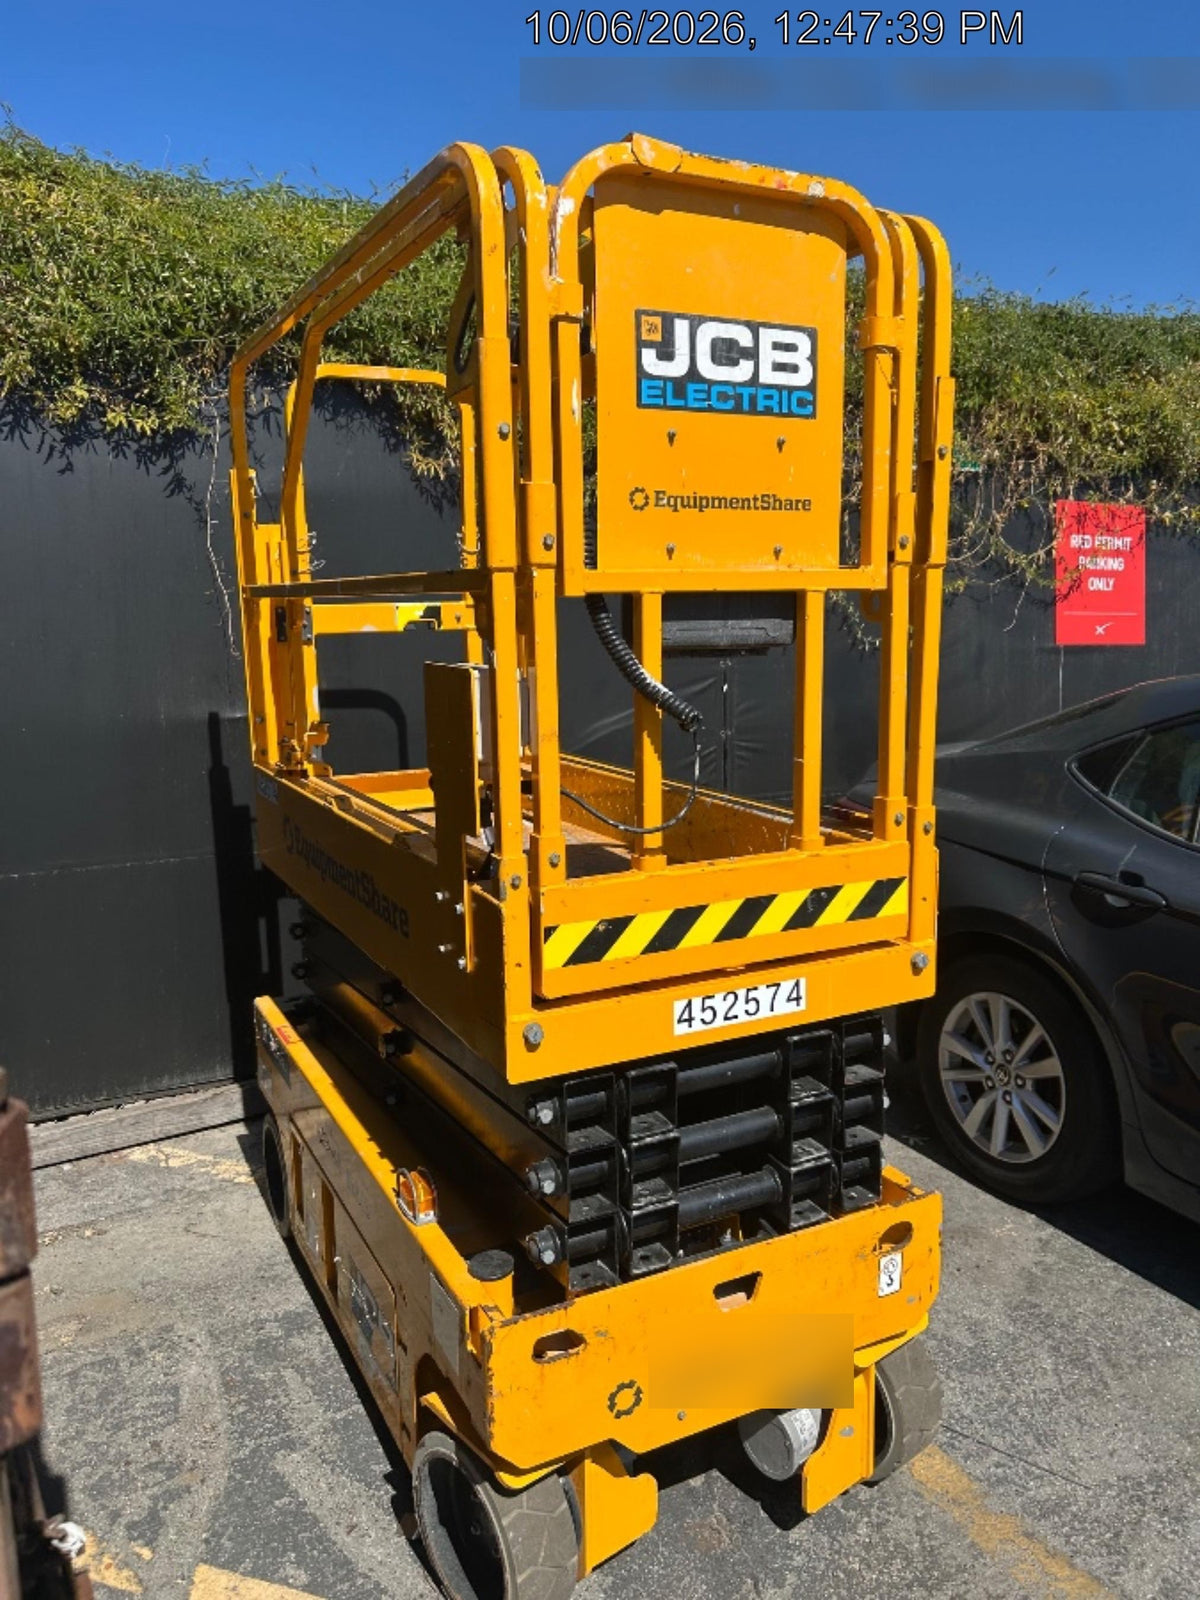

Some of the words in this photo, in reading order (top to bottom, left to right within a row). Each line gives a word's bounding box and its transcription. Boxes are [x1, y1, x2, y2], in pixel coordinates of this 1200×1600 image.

[641, 318, 813, 386] JCB
[641, 379, 813, 415] ELECTRIC
[654, 490, 811, 512] EquipmentShare
[1070, 534, 1093, 549] RED
[1095, 535, 1132, 551] PERMIT
[1088, 577, 1115, 591] ONLY
[293, 822, 410, 939] EquipmentShare
[677, 979, 802, 1028] 452574
